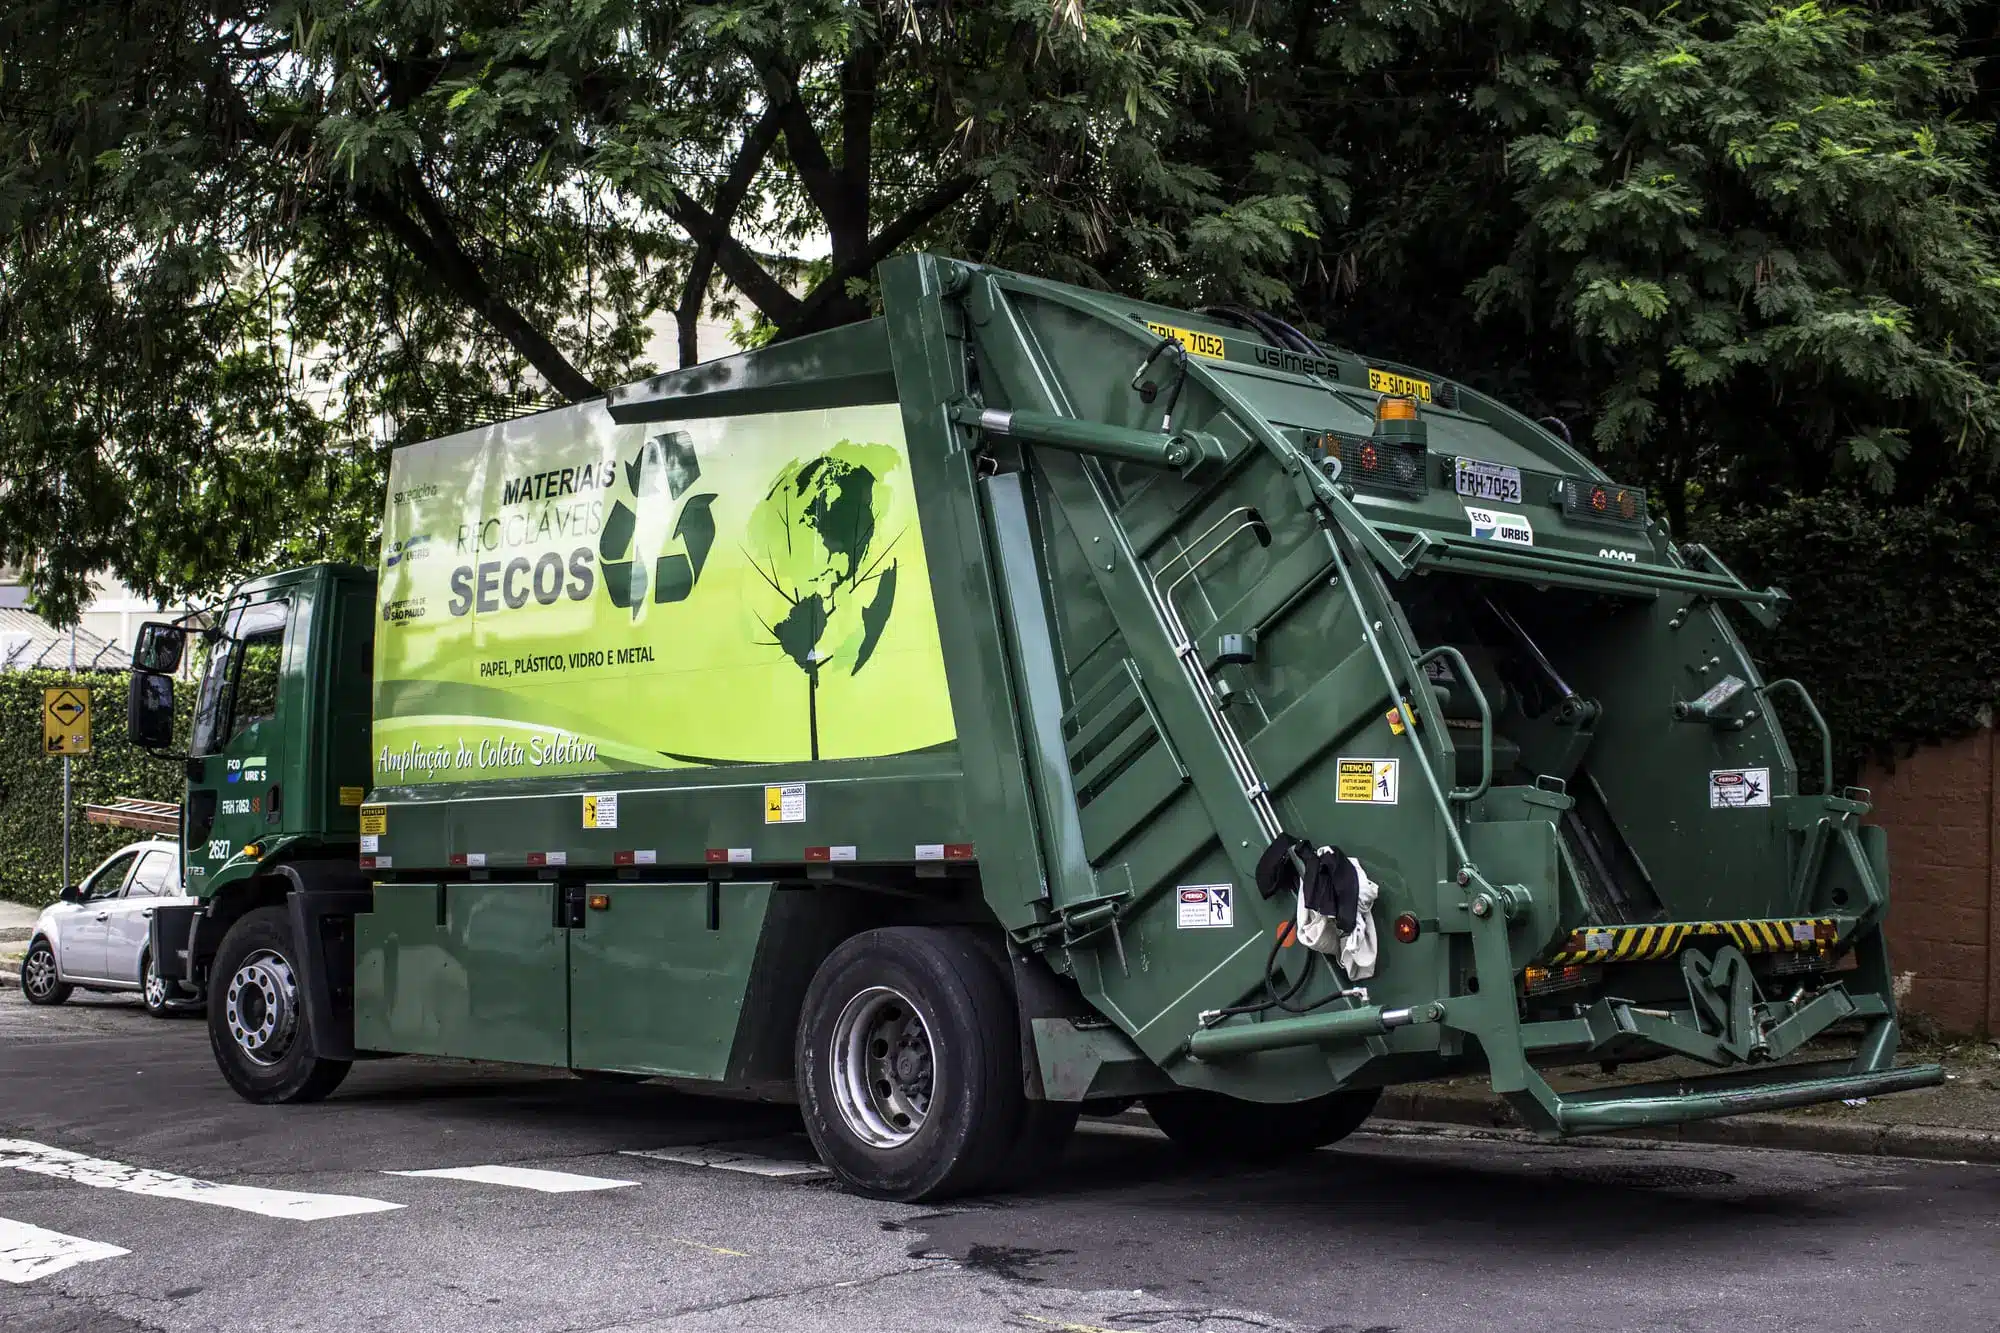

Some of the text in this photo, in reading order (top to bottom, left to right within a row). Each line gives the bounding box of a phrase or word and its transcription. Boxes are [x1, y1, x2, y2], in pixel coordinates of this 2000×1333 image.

[1190, 333, 1223, 356] 7052
[1254, 347, 1340, 381] usimeca
[1371, 372, 1381, 389] SP
[503, 460, 616, 506] MATERIAIS
[1459, 471, 1518, 499] FRH-7052
[456, 499, 602, 555] RECICLÁVEIS
[1471, 511, 1491, 523] ECO
[1501, 527, 1529, 542] URBIS
[448, 547, 594, 616] SECOS
[391, 607, 425, 621] SÃO PAULO
[480, 646, 655, 678] PAPEL, PLÁSTICO, VIDRO E METAL
[378, 733, 597, 781] Ampliação da Coleta Seletiva
[1341, 763, 1372, 773] ATENÇÃO
[235, 799, 250, 813] 7052
[208, 840, 231, 859] 2627
